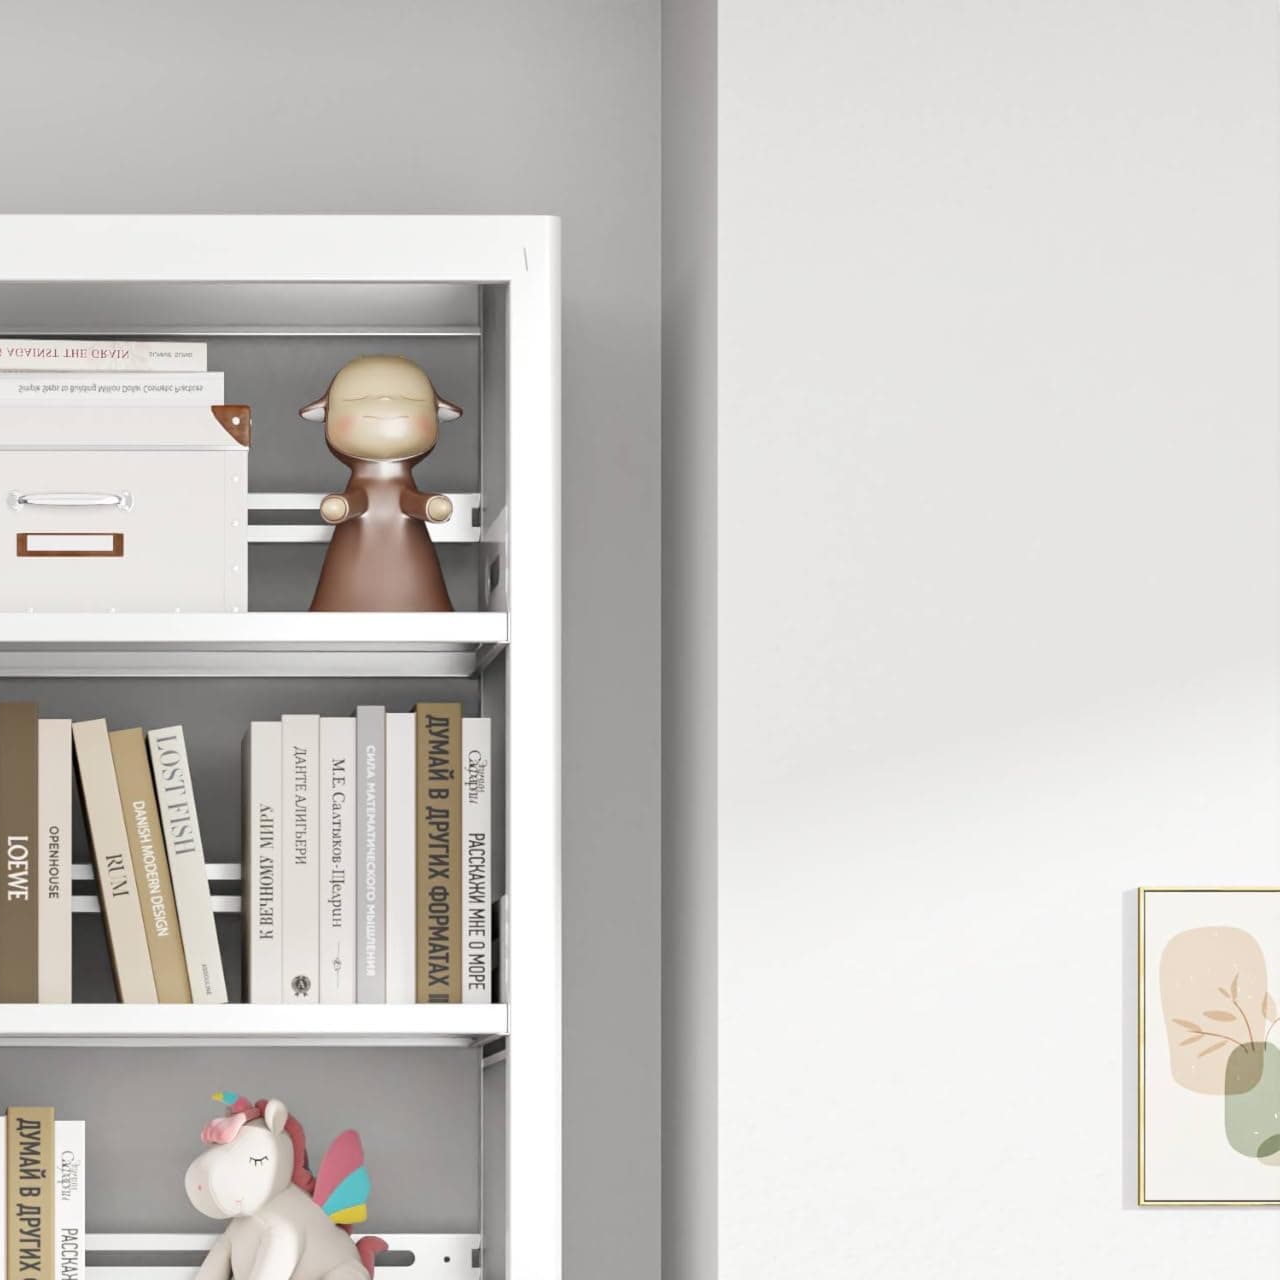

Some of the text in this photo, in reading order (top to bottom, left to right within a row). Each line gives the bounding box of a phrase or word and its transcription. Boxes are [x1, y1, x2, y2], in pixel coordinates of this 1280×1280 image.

[425, 715, 454, 781] ДУМАЙ
[156, 735, 196, 856] LOST FISH
[293, 746, 308, 865] ДАНТЕ АЛИГЬЕРИ
[428, 788, 449, 799] В
[8, 836, 28, 901] LOEWE
[49, 826, 59, 899] OPENHOUSE
[106, 854, 129, 898] RUM
[132, 801, 169, 937] DANISH MODERN DESIGN
[260, 803, 274, 940] К ВЕЧНОМУ МИРУ
[366, 745, 376, 977] СИЛА МАТЕМАТИЧЕСКОГО МЫШЛЕНИЯ
[425, 806, 449, 879] ДРУГИХ
[428, 886, 449, 986] ФОРМАТАХ
[468, 833, 485, 990] РАССКАЖИ МНЕ О МОРЕ
[16, 1118, 46, 1179] ДУМАЙ
[20, 1188, 40, 1197] В
[16, 1204, 40, 1272] ДРУГИХ
